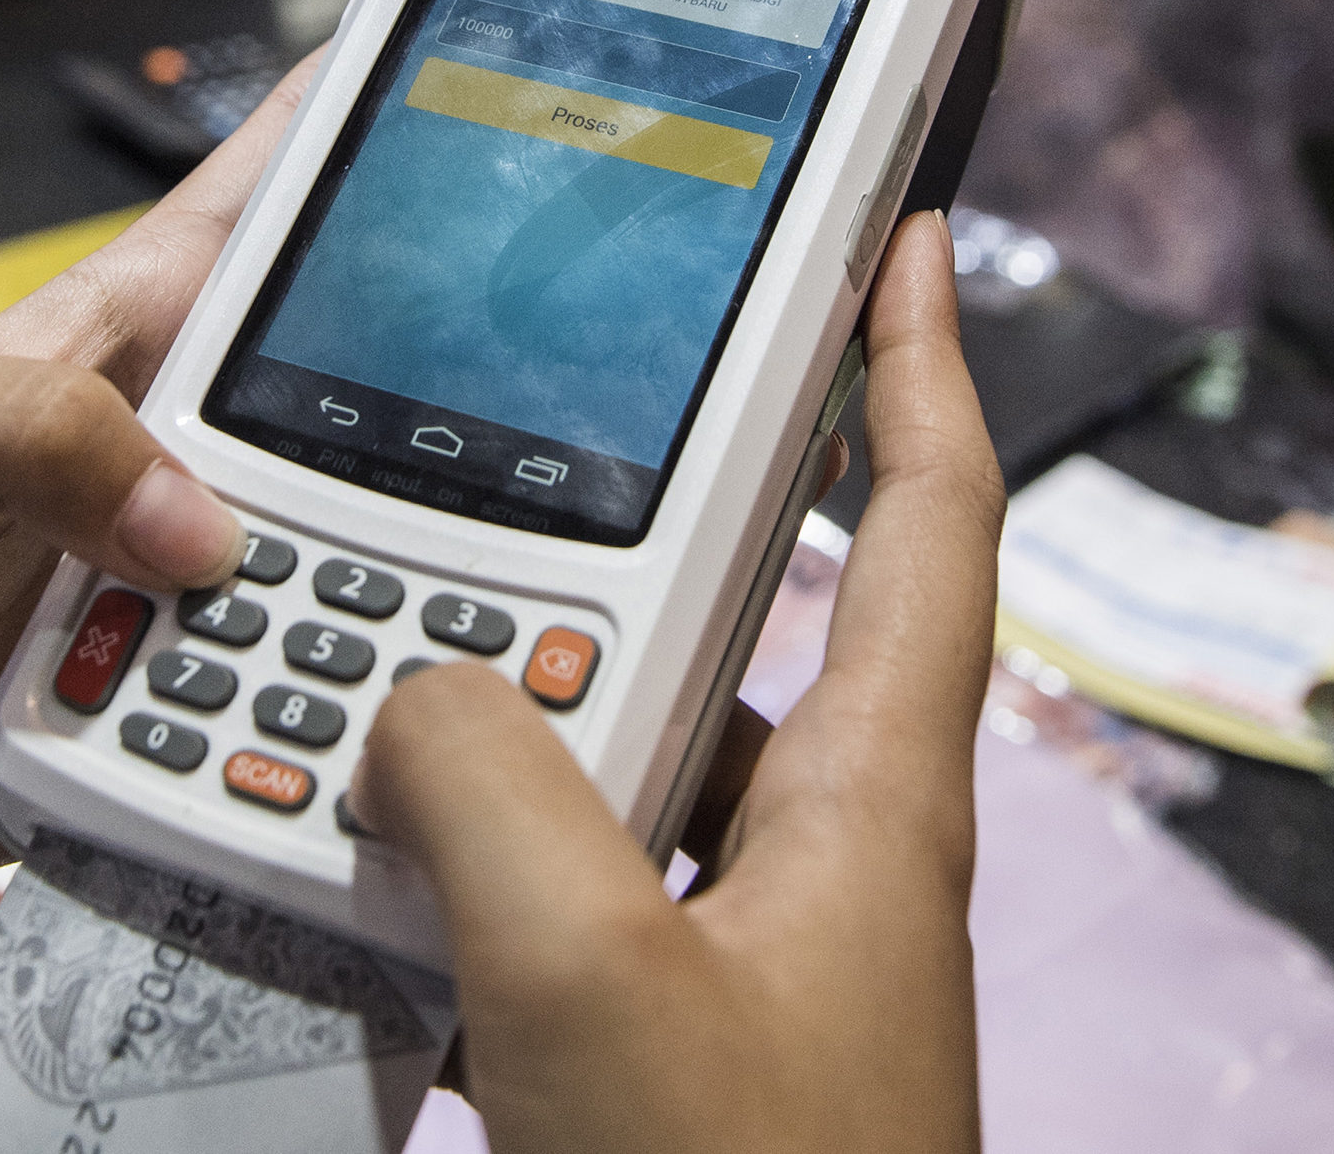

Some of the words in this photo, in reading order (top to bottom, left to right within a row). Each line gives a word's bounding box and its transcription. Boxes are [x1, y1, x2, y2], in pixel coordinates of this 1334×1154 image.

[457, 16, 513, 40] 100000
[550, 106, 620, 137] Proses
[317, 448, 358, 475] PIN
[371, 468, 421, 495] input
[243, 537, 261, 566] 1
[339, 567, 369, 599] 2
[202, 596, 229, 627] 4
[450, 601, 479, 634] 3
[309, 630, 340, 662] 5
[172, 656, 203, 689] 7
[279, 694, 309, 729] 8
[147, 722, 170, 751] 0
[227, 755, 303, 798] SCAN
